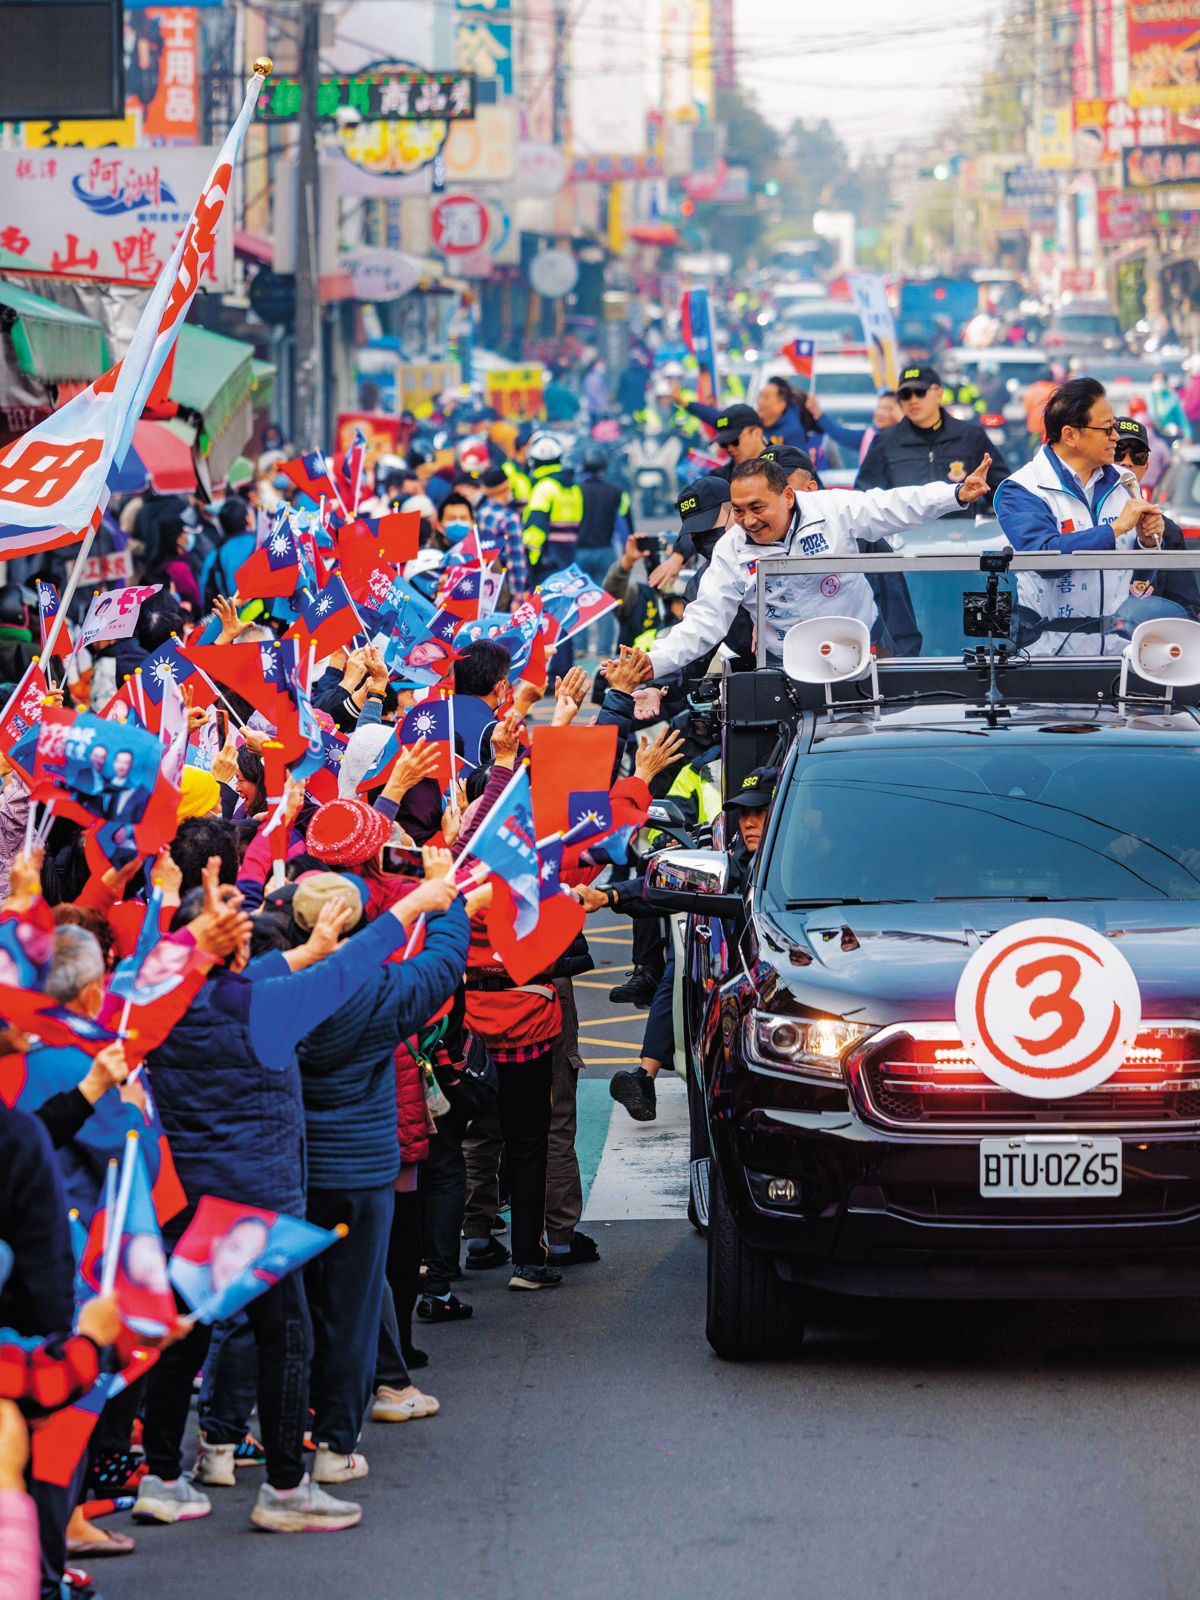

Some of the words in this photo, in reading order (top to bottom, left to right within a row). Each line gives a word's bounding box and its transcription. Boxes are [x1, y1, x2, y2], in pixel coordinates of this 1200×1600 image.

[1120, 421, 1139, 432] SSC
[680, 498, 696, 513] SSC
[800, 533, 827, 553] 2024
[742, 776, 759, 788] SSC
[1014, 954, 1086, 1056] 3
